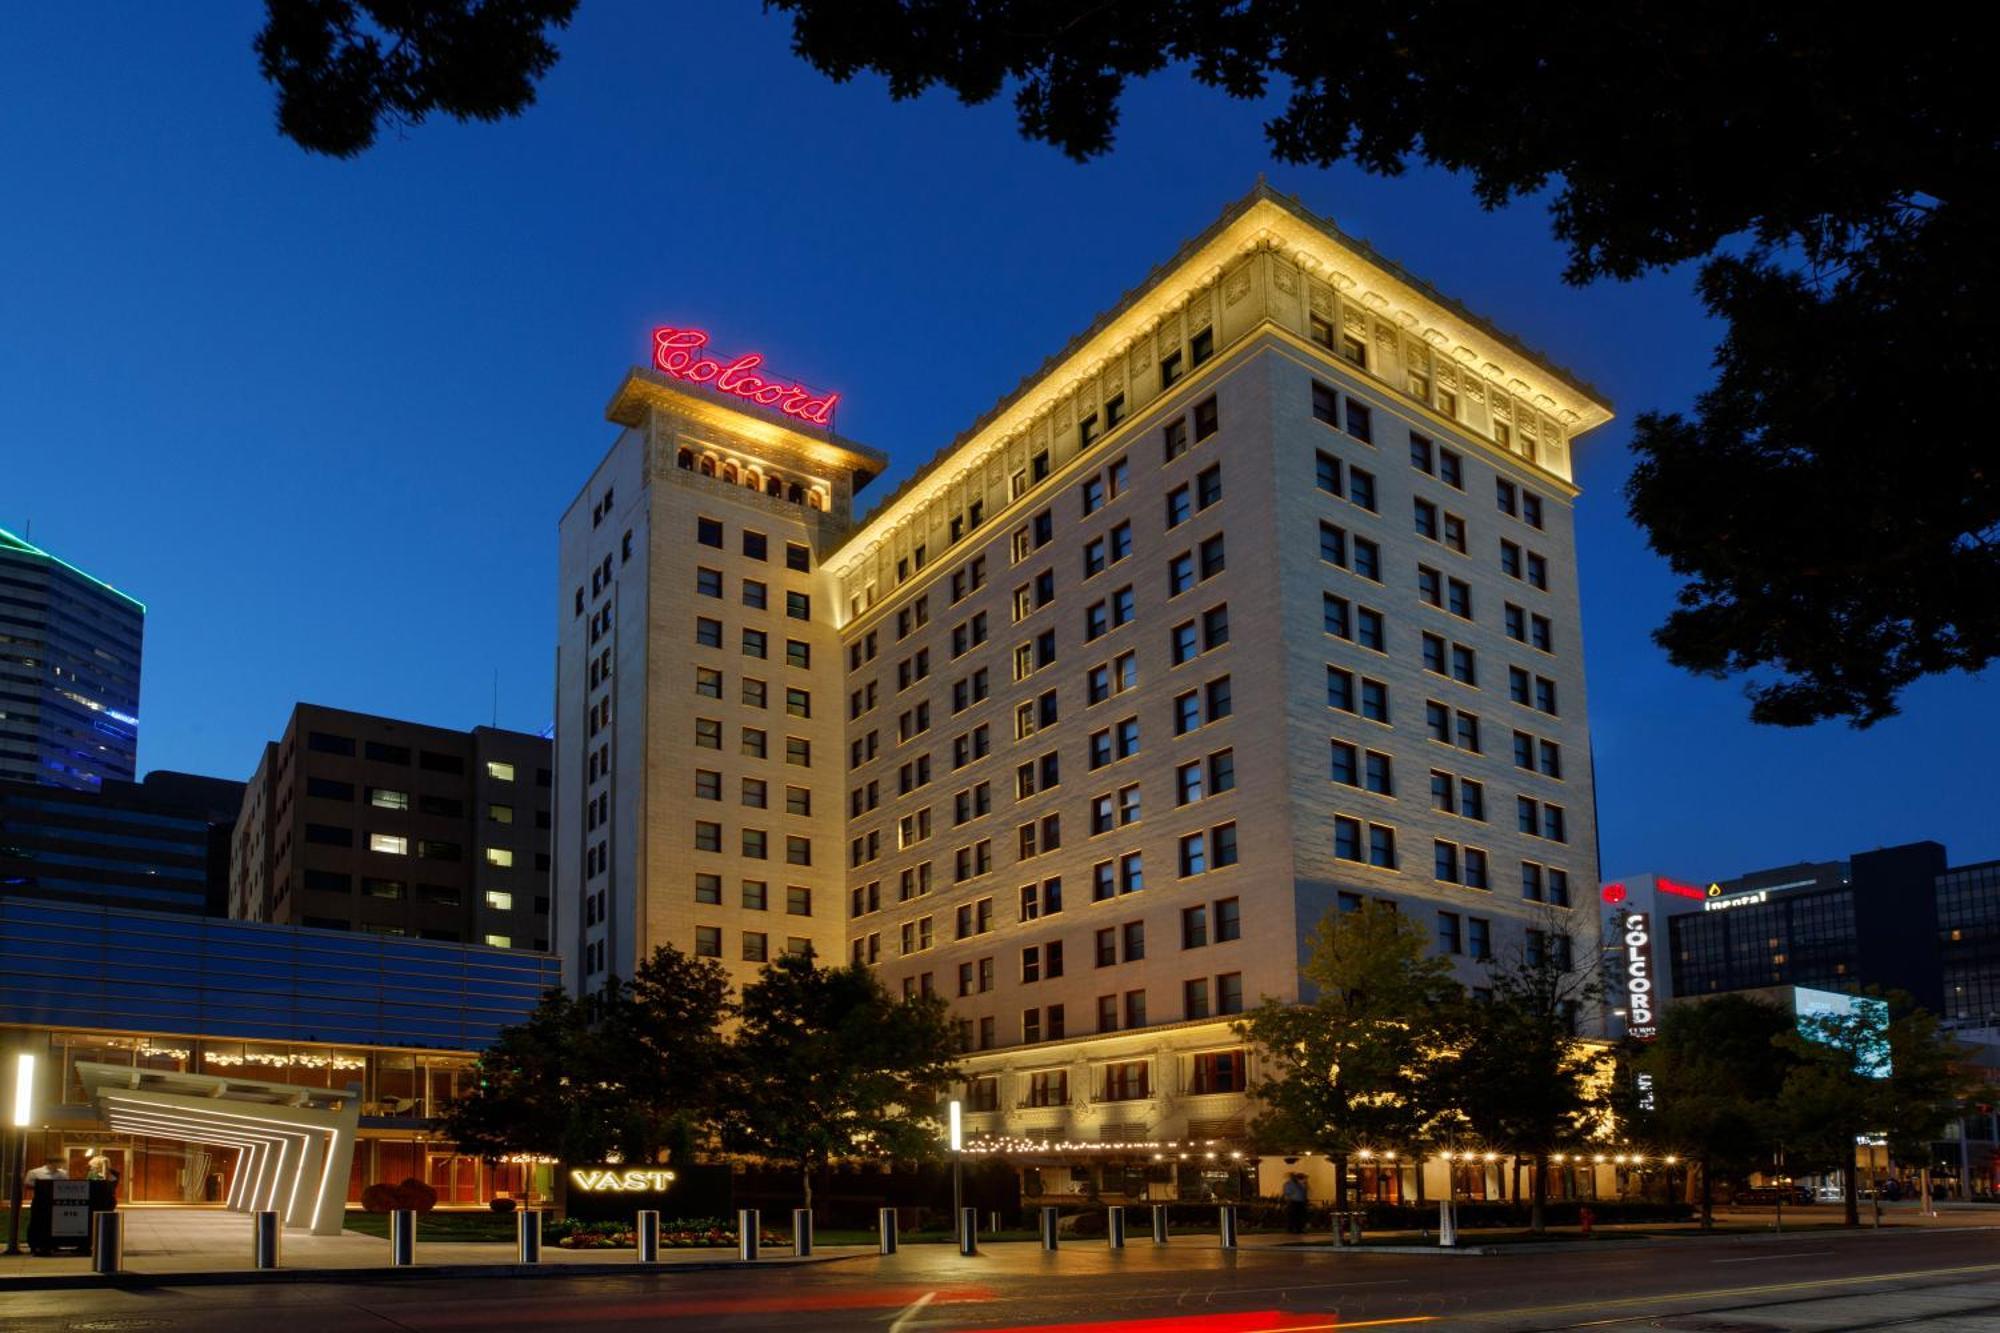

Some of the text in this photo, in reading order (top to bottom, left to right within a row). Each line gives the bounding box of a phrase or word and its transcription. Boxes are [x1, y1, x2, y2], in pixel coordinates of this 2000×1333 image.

[655, 328, 838, 424] Colcord
[1625, 914, 1652, 1024] COLCORD
[571, 1169, 676, 1192] VAST
